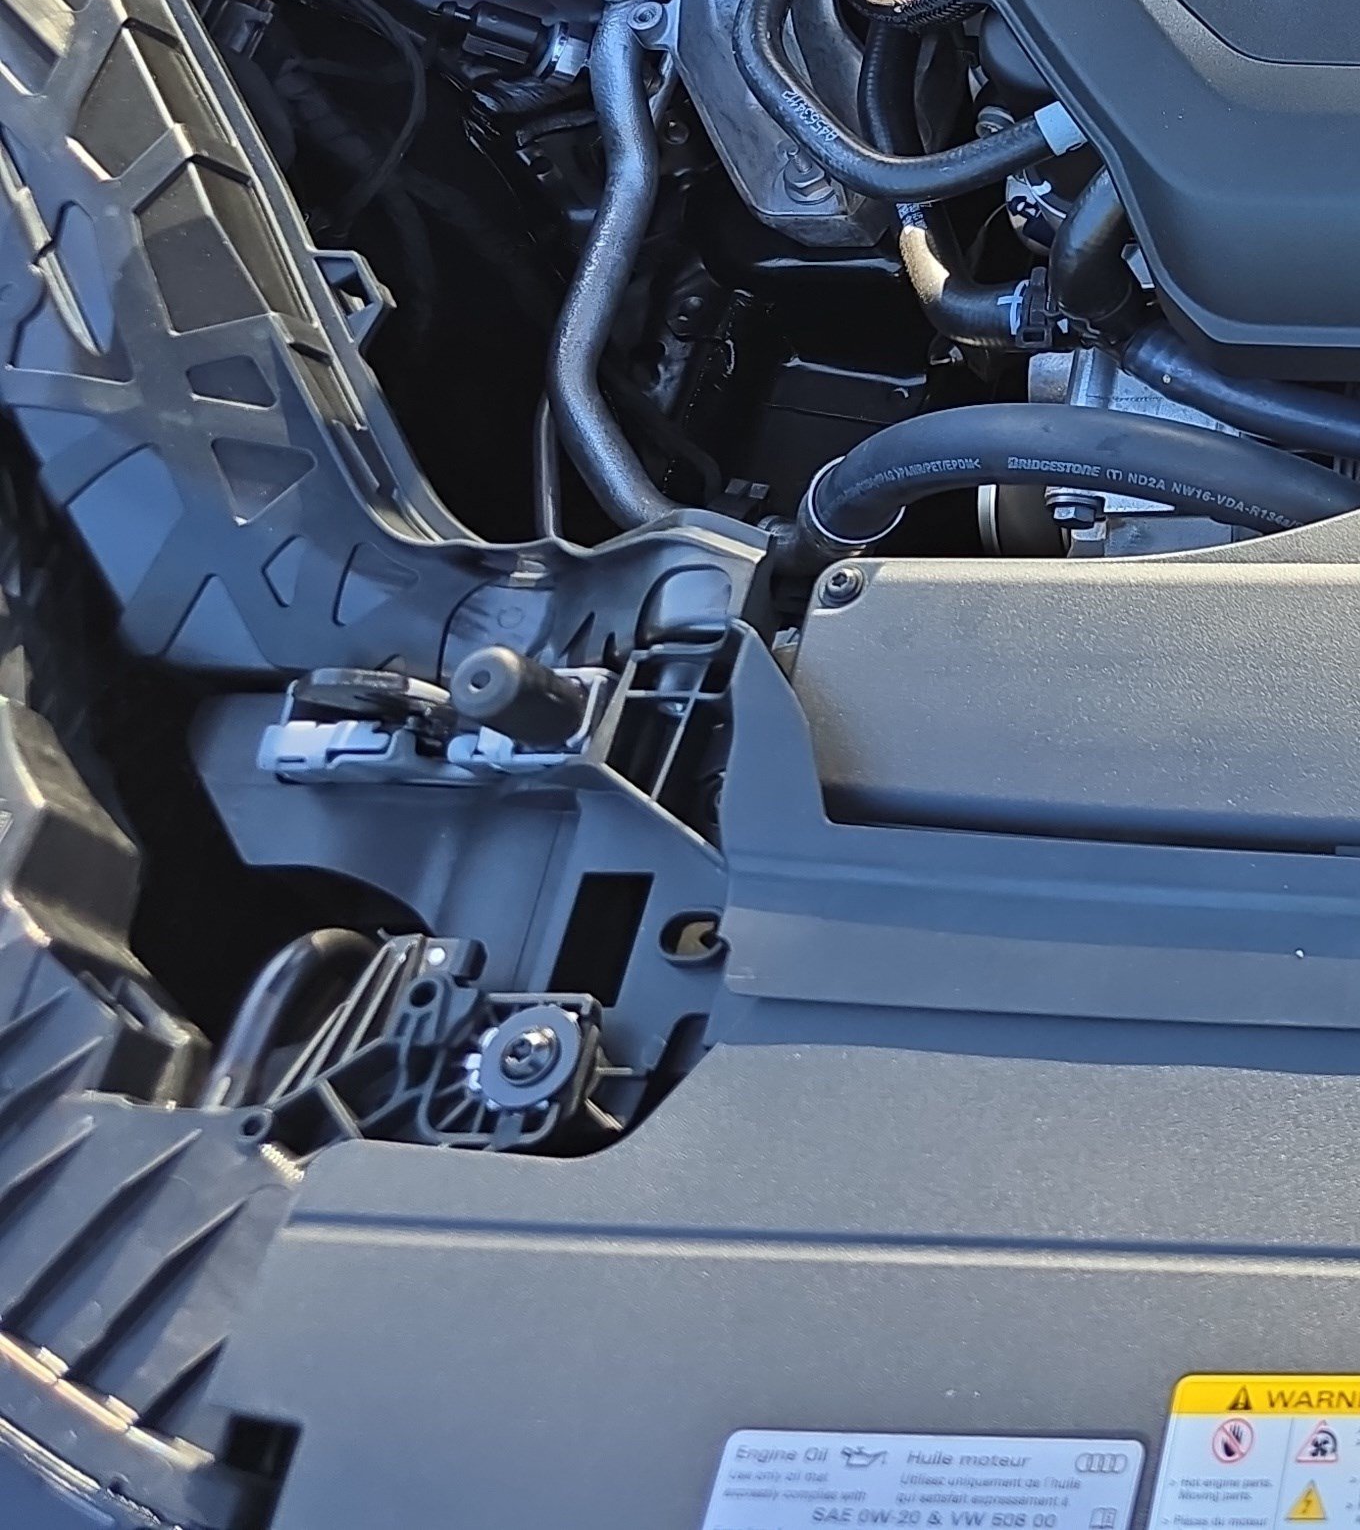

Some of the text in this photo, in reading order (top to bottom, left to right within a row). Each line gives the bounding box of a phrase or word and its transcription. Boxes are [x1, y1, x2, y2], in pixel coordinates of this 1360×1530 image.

[1008, 456, 1100, 477] BRIDGESTONE
[1128, 472, 1166, 490] ND2A
[736, 1445, 1032, 1468] Engine Oil Huile moteur
[812, 1507, 852, 1522] SAE
[857, 1508, 921, 1524] 0W-20
[927, 1511, 942, 1525] &
[951, 1511, 986, 1525] VW
